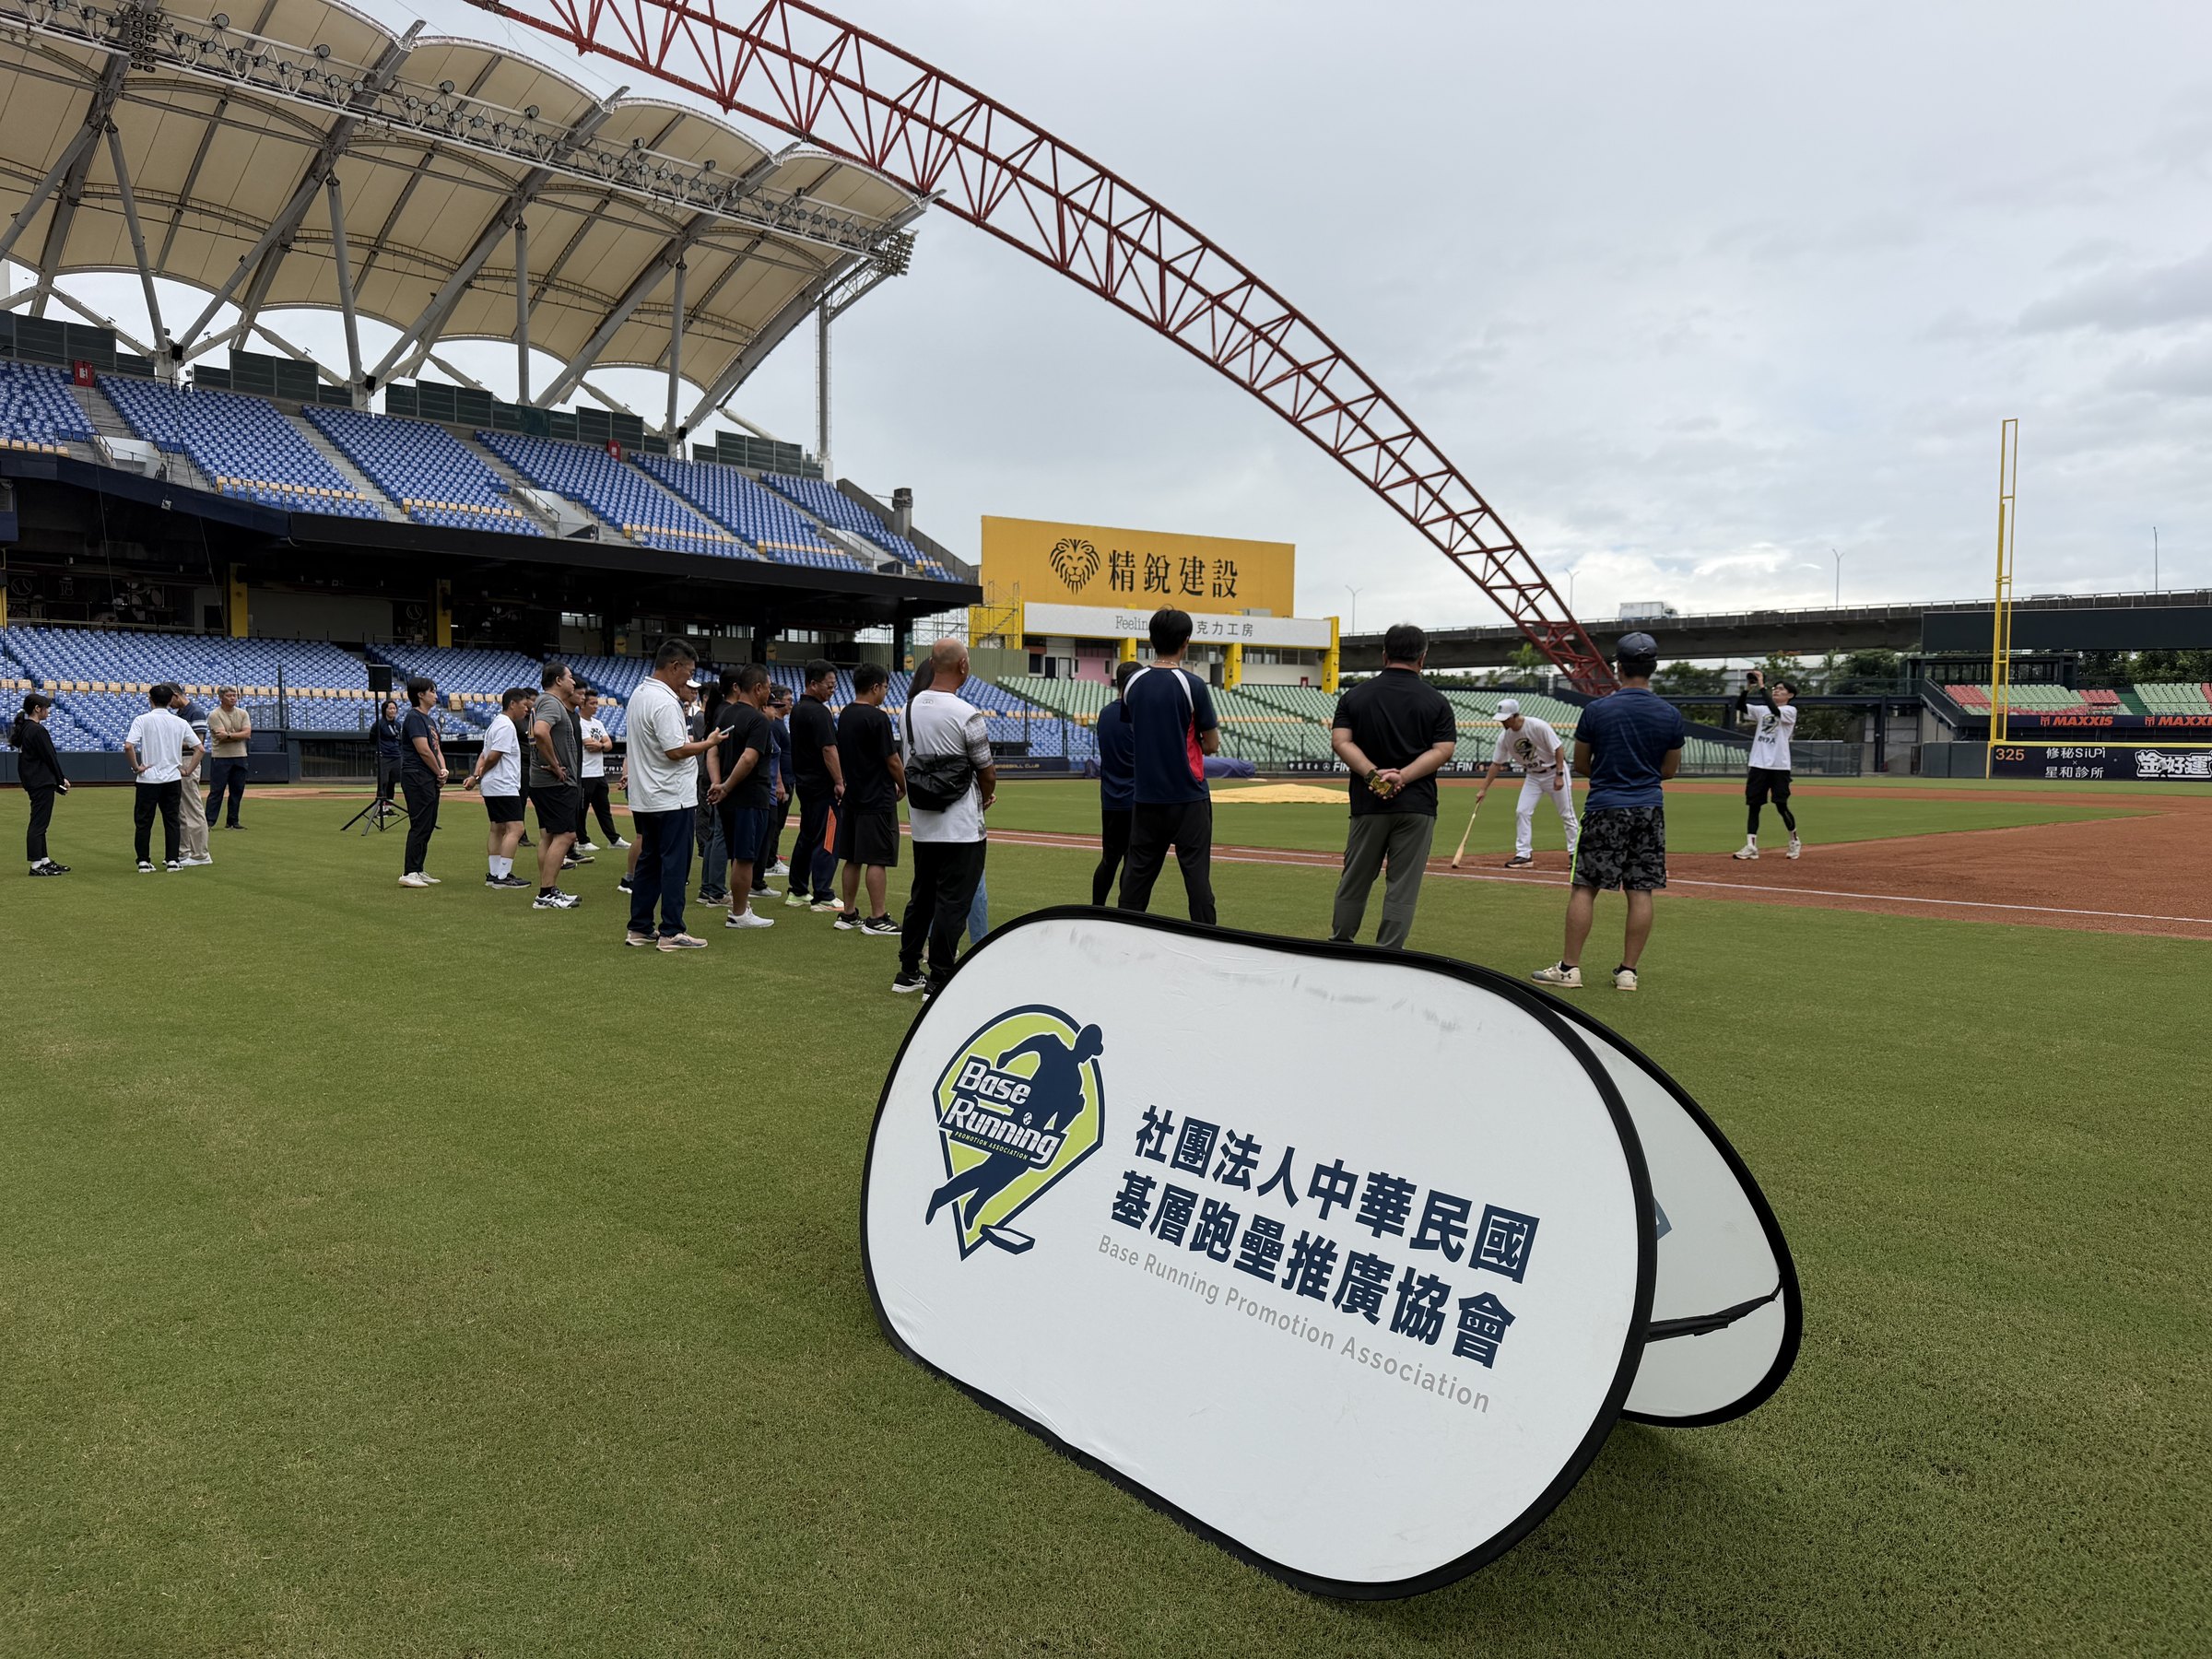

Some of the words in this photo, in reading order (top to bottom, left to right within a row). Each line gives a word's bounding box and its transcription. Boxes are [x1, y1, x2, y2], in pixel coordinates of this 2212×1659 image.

[1108, 549, 1239, 599] 精銳建設
[1115, 616, 1149, 631] Feelin
[2053, 715, 2114, 726] MAXXIS
[2158, 715, 2212, 726] MAXXI
[1456, 761, 1474, 771] FIN
[1995, 748, 2025, 761] 325
[2044, 766, 2105, 779] 星和診所
[958, 1060, 1031, 1105] Base
[945, 1097, 1061, 1163] Running
[954, 1131, 988, 1147] PROMOTION
[988, 1142, 1029, 1160] ASSOCIATION
[1135, 1104, 1540, 1285] 社團法人中華民國
[1111, 1170, 1516, 1370] 基層跑壘推廣協會
[1098, 1234, 1139, 1266] Base
[1144, 1253, 1220, 1305] Running
[1225, 1287, 1335, 1350] Promotion
[1340, 1336, 1490, 1414] Association
